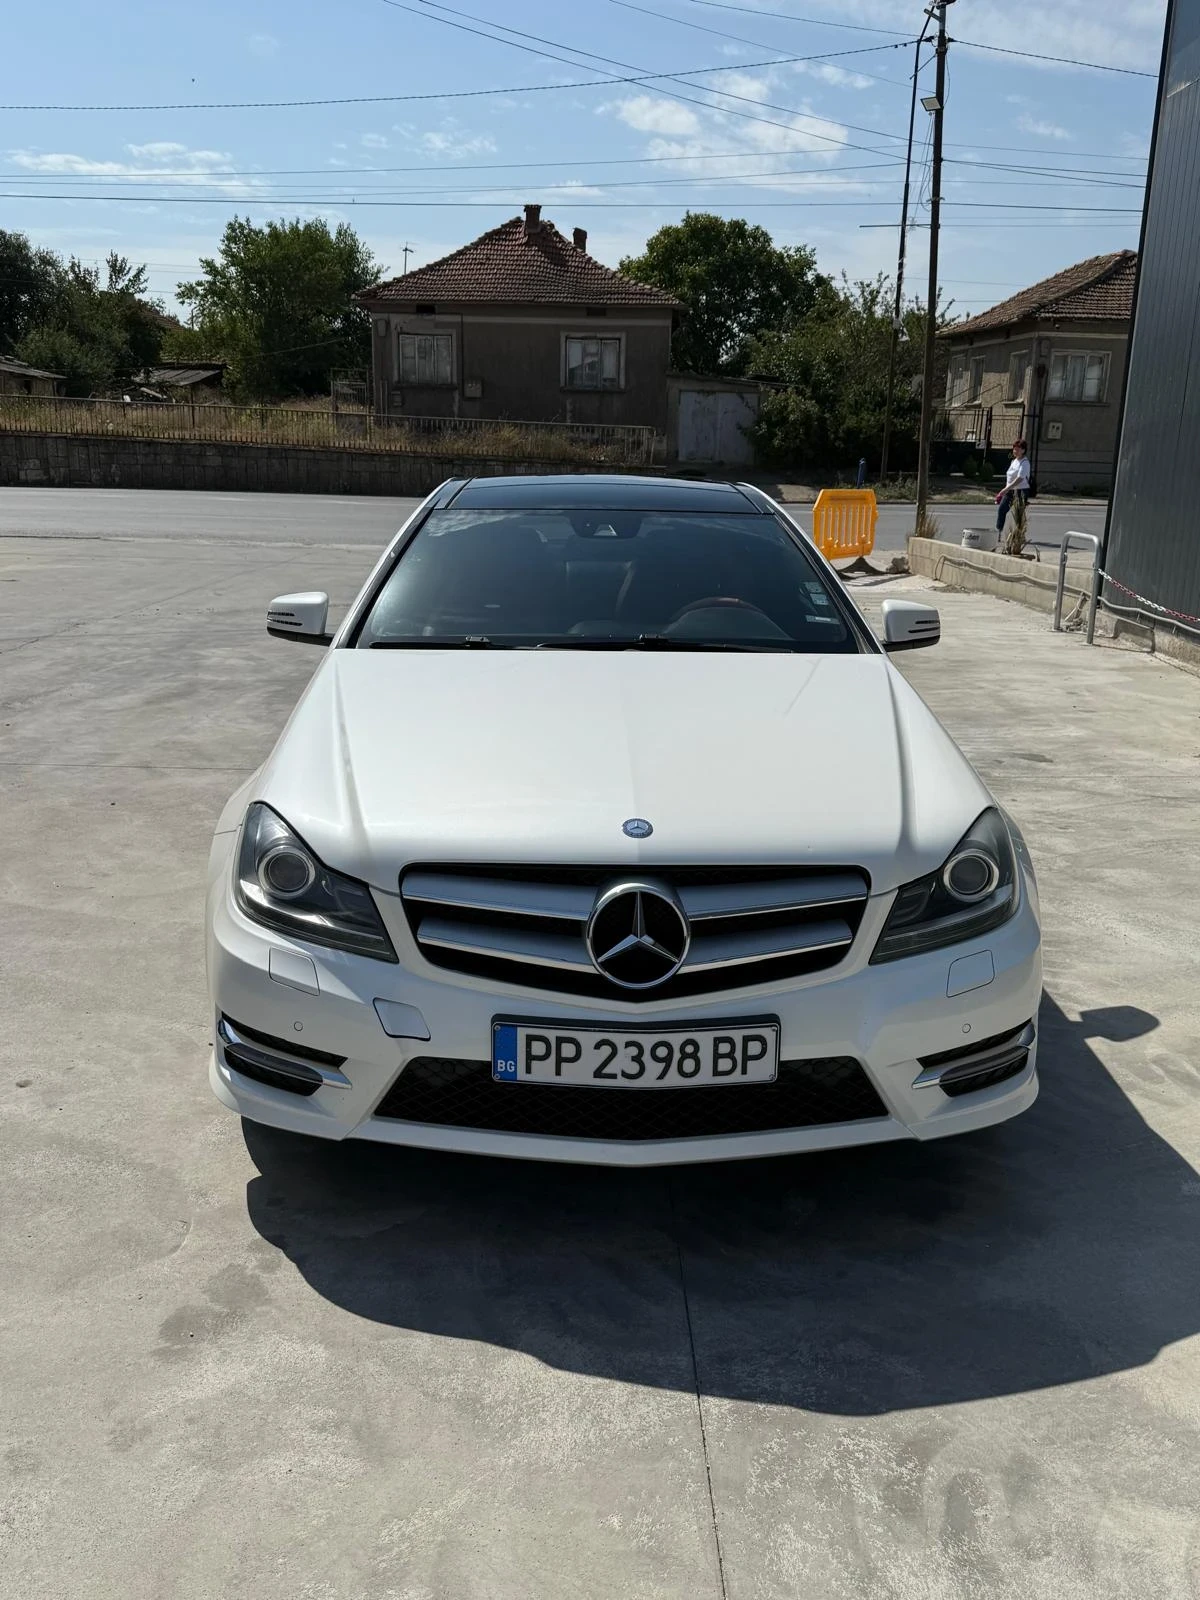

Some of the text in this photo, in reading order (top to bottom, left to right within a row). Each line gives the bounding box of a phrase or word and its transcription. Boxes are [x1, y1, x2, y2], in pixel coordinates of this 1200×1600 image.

[497, 1060, 515, 1072] BG
[525, 1034, 768, 1080] PP 2398 BP
